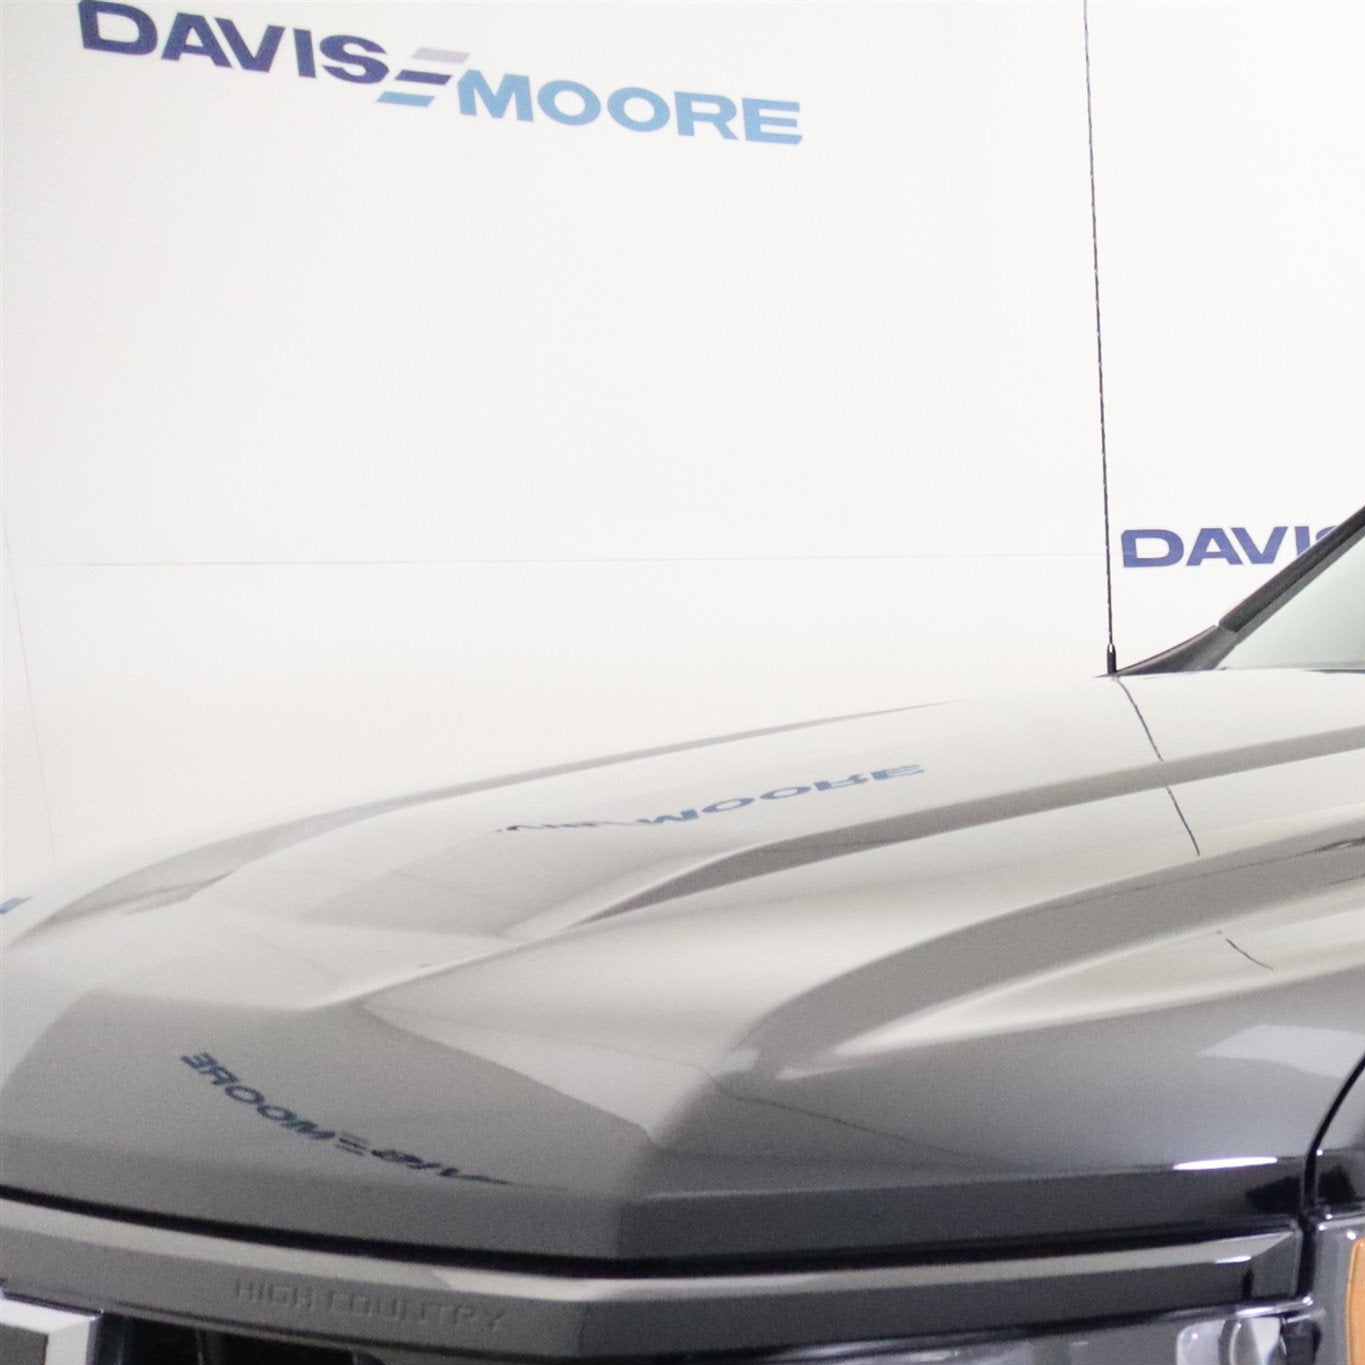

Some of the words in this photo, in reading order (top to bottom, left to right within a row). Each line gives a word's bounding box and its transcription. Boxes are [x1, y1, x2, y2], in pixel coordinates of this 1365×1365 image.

[78, 0, 390, 85] DAVIS
[457, 69, 803, 146] MOORE
[1120, 525, 1341, 568] DAVI
